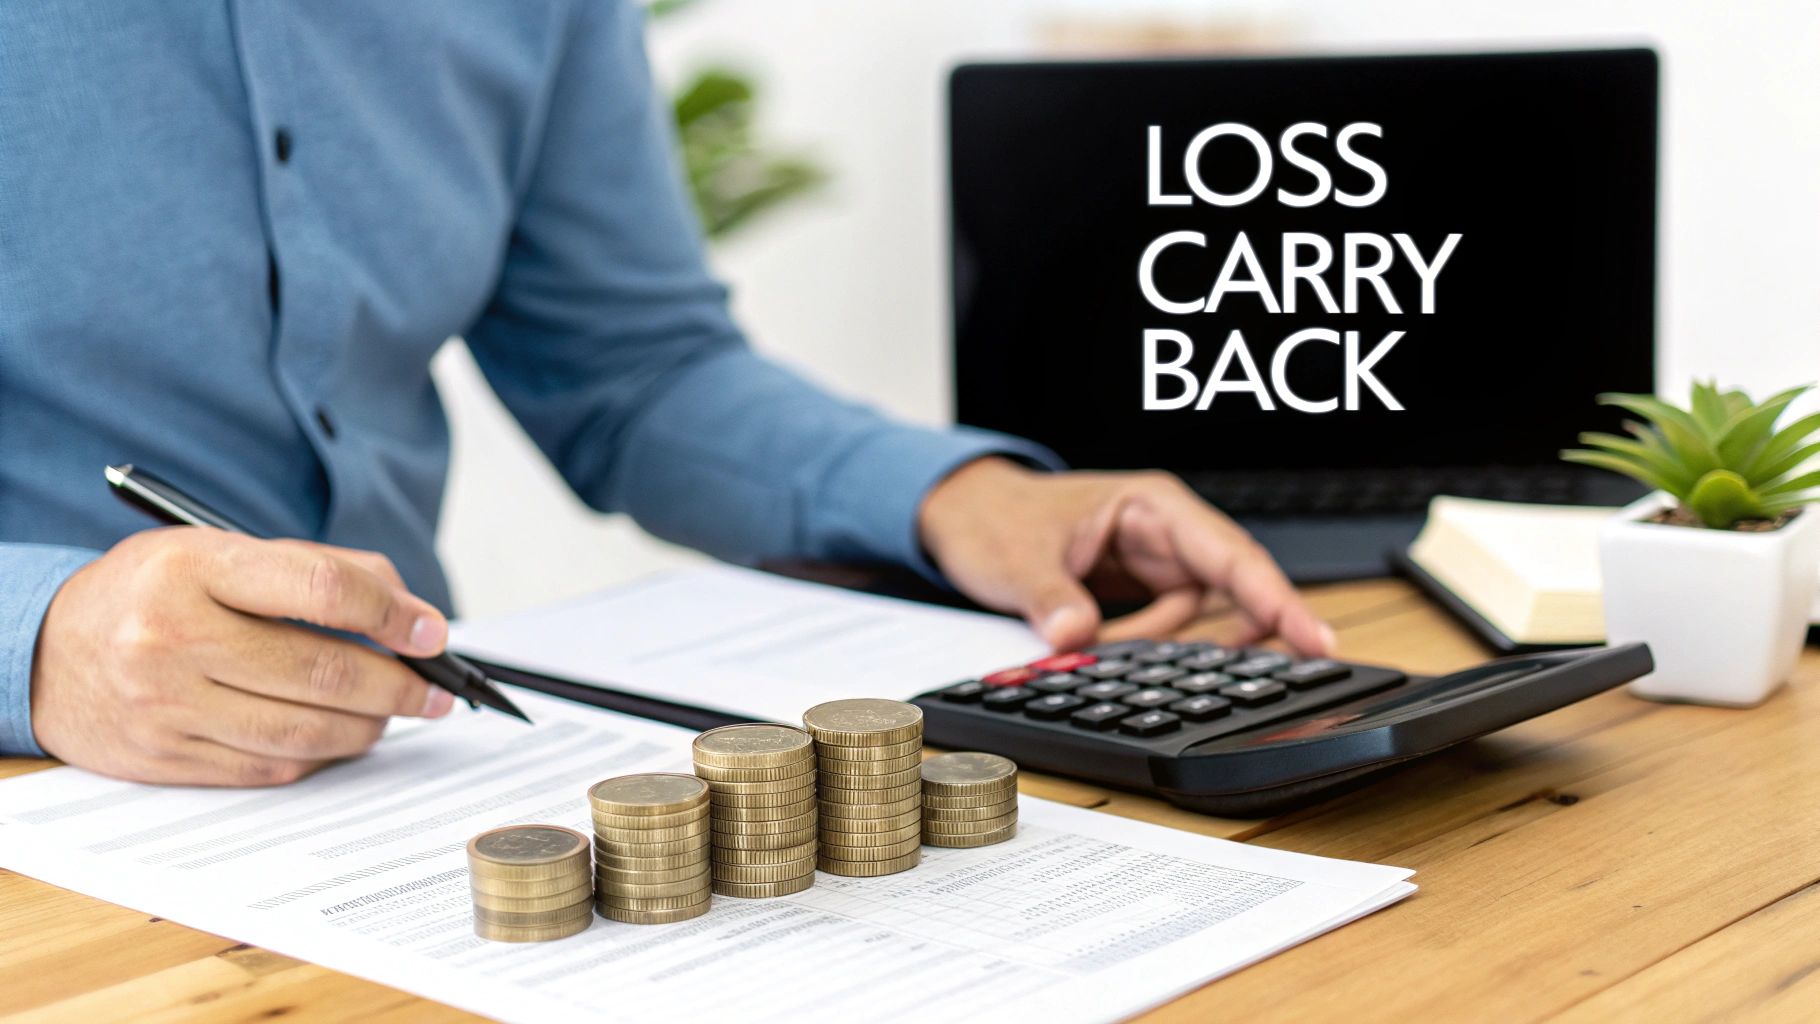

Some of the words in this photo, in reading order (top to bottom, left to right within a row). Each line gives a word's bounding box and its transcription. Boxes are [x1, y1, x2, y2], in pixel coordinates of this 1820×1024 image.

[1147, 121, 1388, 208] LOSS
[1138, 230, 1463, 315] CARRY
[1142, 327, 1407, 413] BACK
